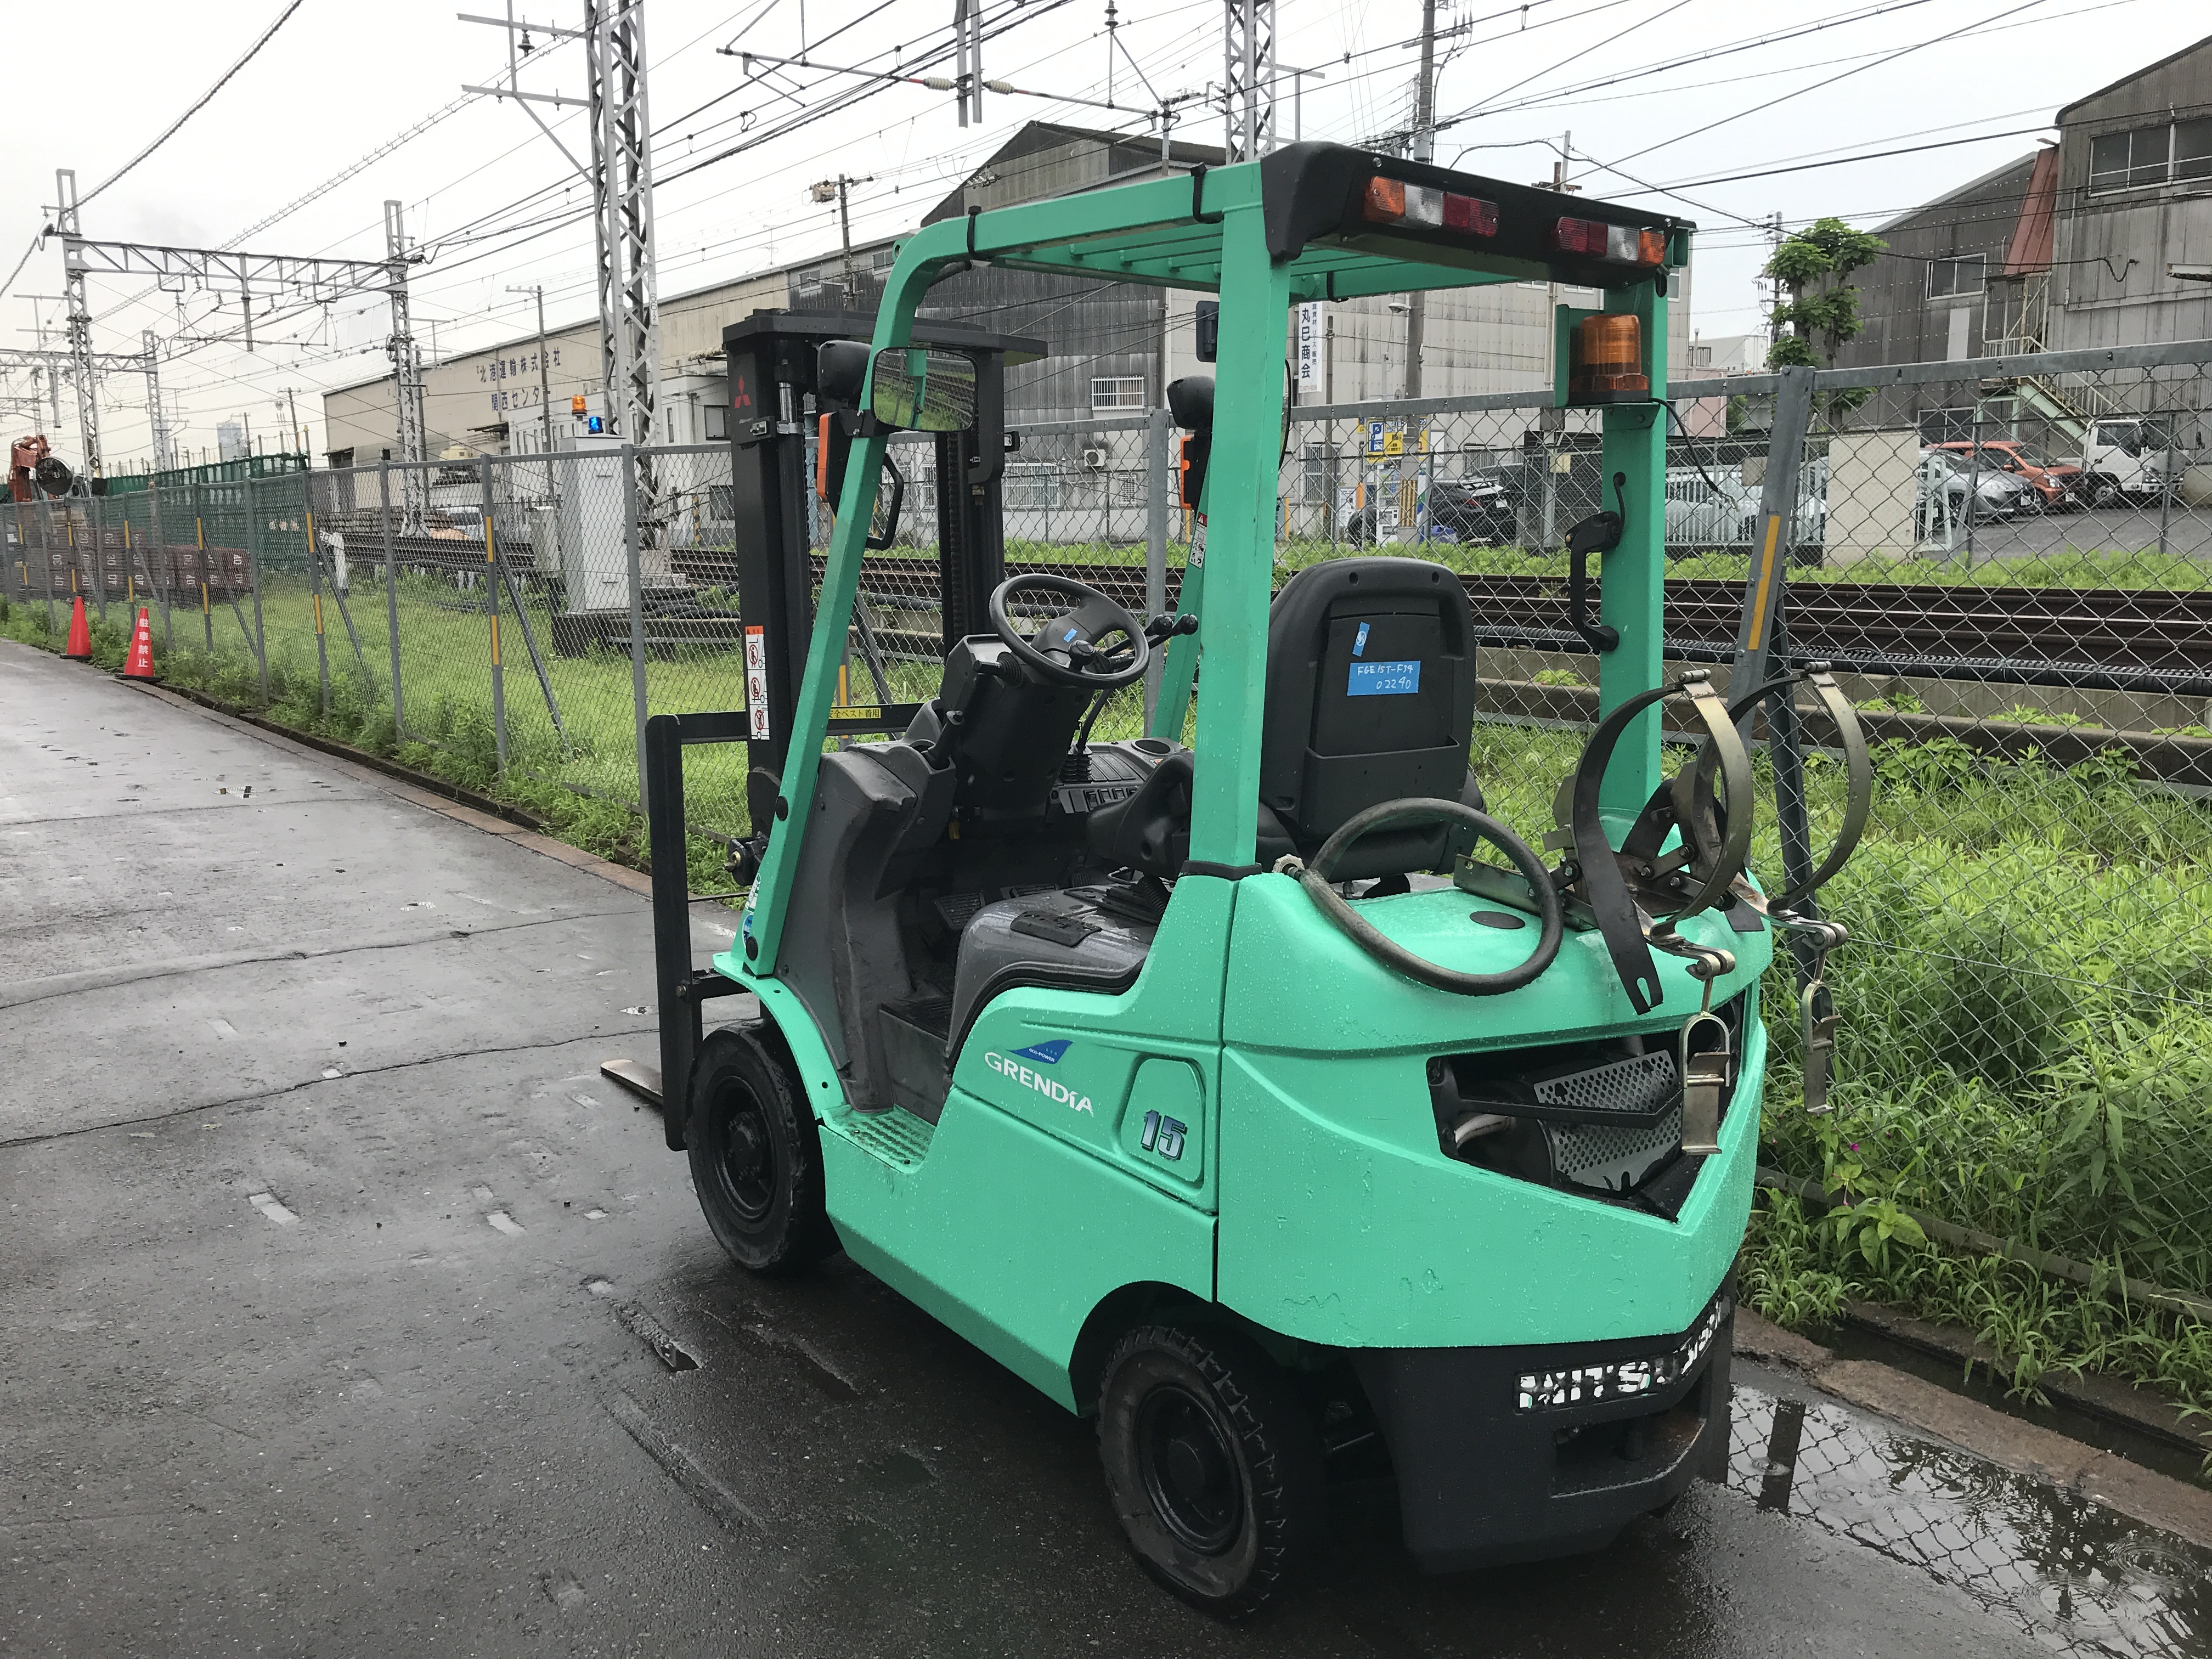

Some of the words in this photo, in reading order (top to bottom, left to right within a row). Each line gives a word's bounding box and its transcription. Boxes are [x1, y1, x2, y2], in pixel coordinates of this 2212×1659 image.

[138, 618, 149, 668] 駐車禁止
[1141, 1109, 1187, 1161] 15
